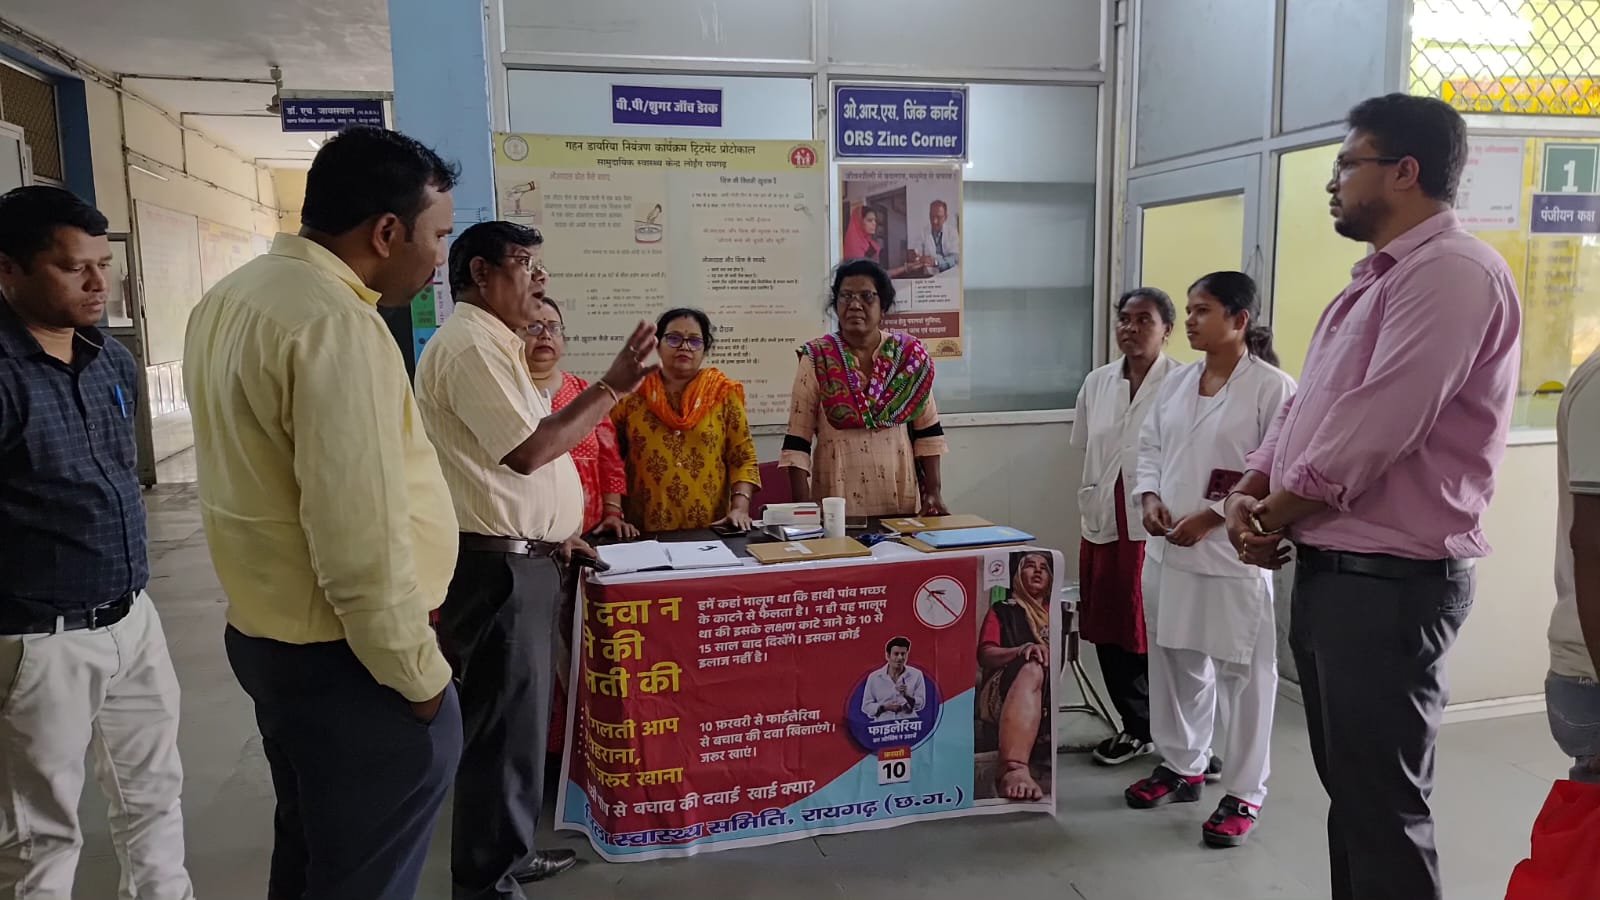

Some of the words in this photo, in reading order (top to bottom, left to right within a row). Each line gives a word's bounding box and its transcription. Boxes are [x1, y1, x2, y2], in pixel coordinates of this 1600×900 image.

[843, 97, 899, 122] ओ.आर.एस.
[904, 98, 927, 120] जिंक
[930, 100, 959, 120] कार्नर
[565, 141, 583, 151] गहन
[587, 139, 618, 151] डायरिया
[844, 130, 873, 146] ORS
[877, 131, 907, 146] Zinc
[911, 131, 957, 147] Corner
[1562, 160, 1578, 192] 1
[1540, 206, 1574, 222] पंजीयन
[1578, 210, 1596, 222] कक्ष
[697, 597, 715, 610] हमें
[717, 595, 741, 608] कहां
[743, 595, 774, 608] मालूम
[777, 594, 791, 603] था
[793, 590, 808, 602] कि
[811, 588, 835, 601] हाथी
[837, 586, 857, 598] पांव
[860, 585, 887, 596] मच्छर
[593, 600, 652, 627] दवा
[658, 597, 682, 621] न
[698, 613, 710, 624] के
[713, 611, 743, 623] काटने
[745, 609, 756, 620] से
[759, 606, 793, 619] फैलता
[815, 605, 823, 614] न
[826, 602, 837, 613] ही
[840, 602, 856, 612] यह
[858, 599, 887, 612] मालूम
[698, 629, 712, 638] था
[715, 625, 731, 637] की
[733, 623, 762, 637] इसके
[764, 621, 796, 633] लक्षण
[798, 617, 821, 629] काटे
[823, 615, 843, 628] जाने
[845, 614, 856, 625] के
[859, 615, 871, 624] 10
[873, 611, 884, 622] से
[600, 629, 645, 662] की
[698, 644, 711, 653] 15
[714, 641, 739, 652] साल
[741, 639, 762, 649] बाद
[805, 631, 836, 644] इसका
[838, 627, 860, 640] कोई
[697, 656, 730, 668] इलाज
[732, 651, 754, 664] नहीं
[637, 661, 682, 693] की
[590, 717, 636, 739] गलती
[642, 717, 680, 736] आप
[699, 722, 713, 732] 10
[754, 713, 764, 725] से
[868, 720, 922, 735] फाइलेरिया
[700, 735, 710, 747] से
[713, 733, 743, 746] बचाव
[745, 728, 760, 741] की
[763, 728, 784, 739] दवा
[635, 767, 684, 786] खाना
[882, 761, 906, 780] 10
[612, 801, 627, 817] से
[633, 800, 675, 815] बचाव
[679, 792, 699, 811] की
[702, 785, 741, 805] दवाई
[746, 780, 778, 800] खाई
[780, 780, 816, 795] क्या?
[613, 823, 704, 846] स्वास्थ्य
[801, 799, 879, 818] रायगढ़
